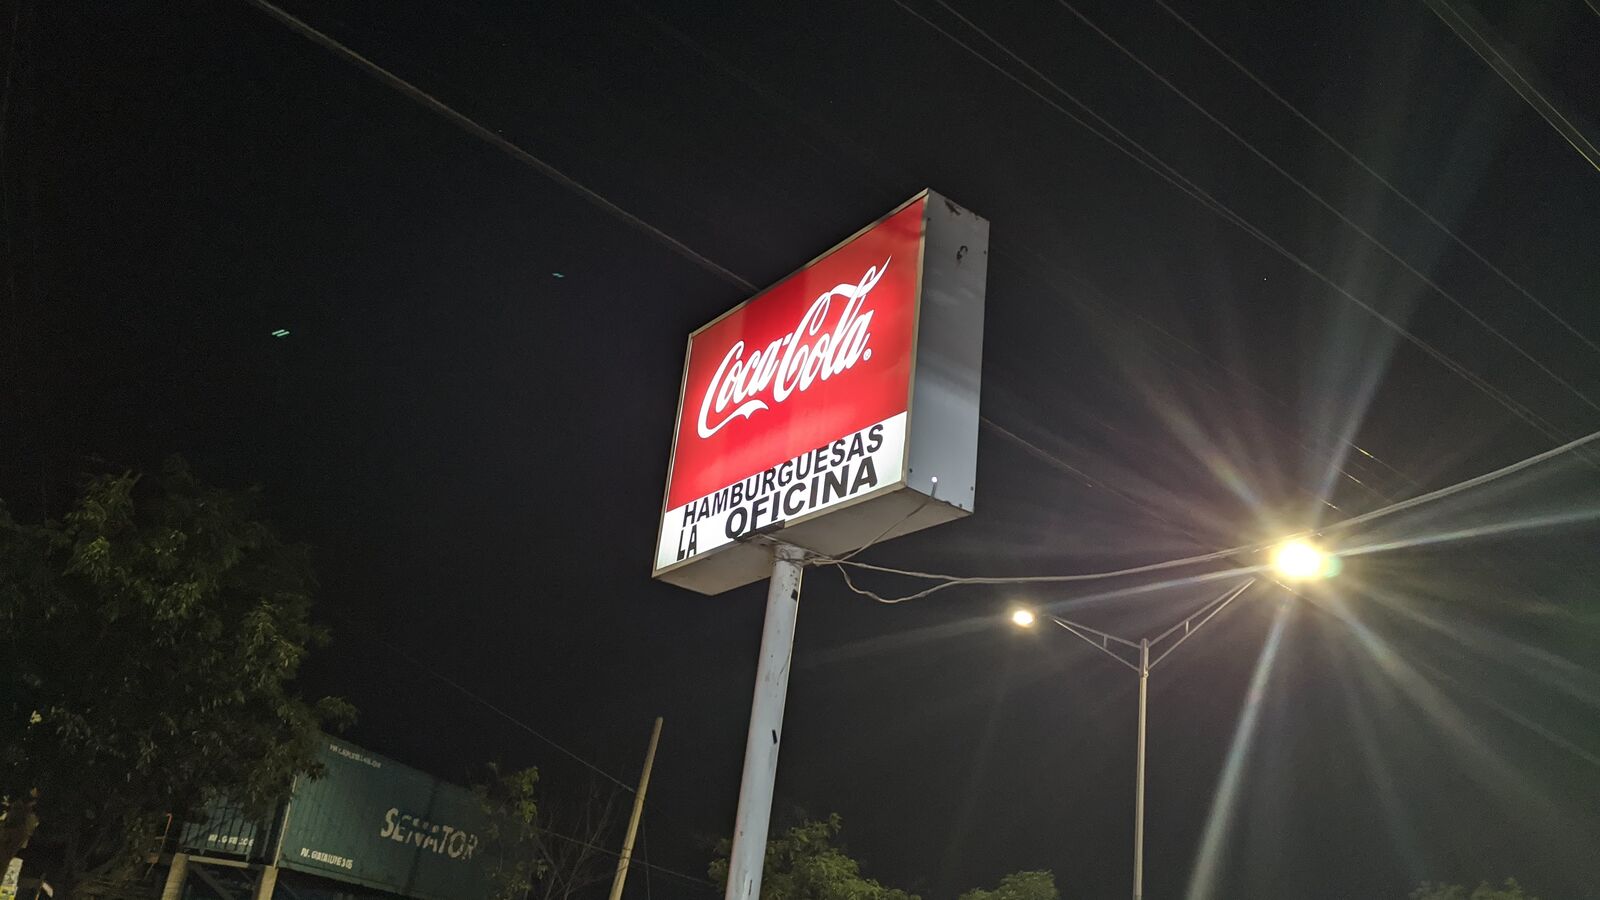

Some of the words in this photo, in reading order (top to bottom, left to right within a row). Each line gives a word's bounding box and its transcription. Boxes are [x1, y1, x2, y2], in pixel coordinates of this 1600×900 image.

[697, 256, 892, 439] Coca-Cola
[676, 525, 698, 561] LA
[725, 456, 878, 540] OFICINA
[682, 423, 884, 528] HAMBURGUESAS
